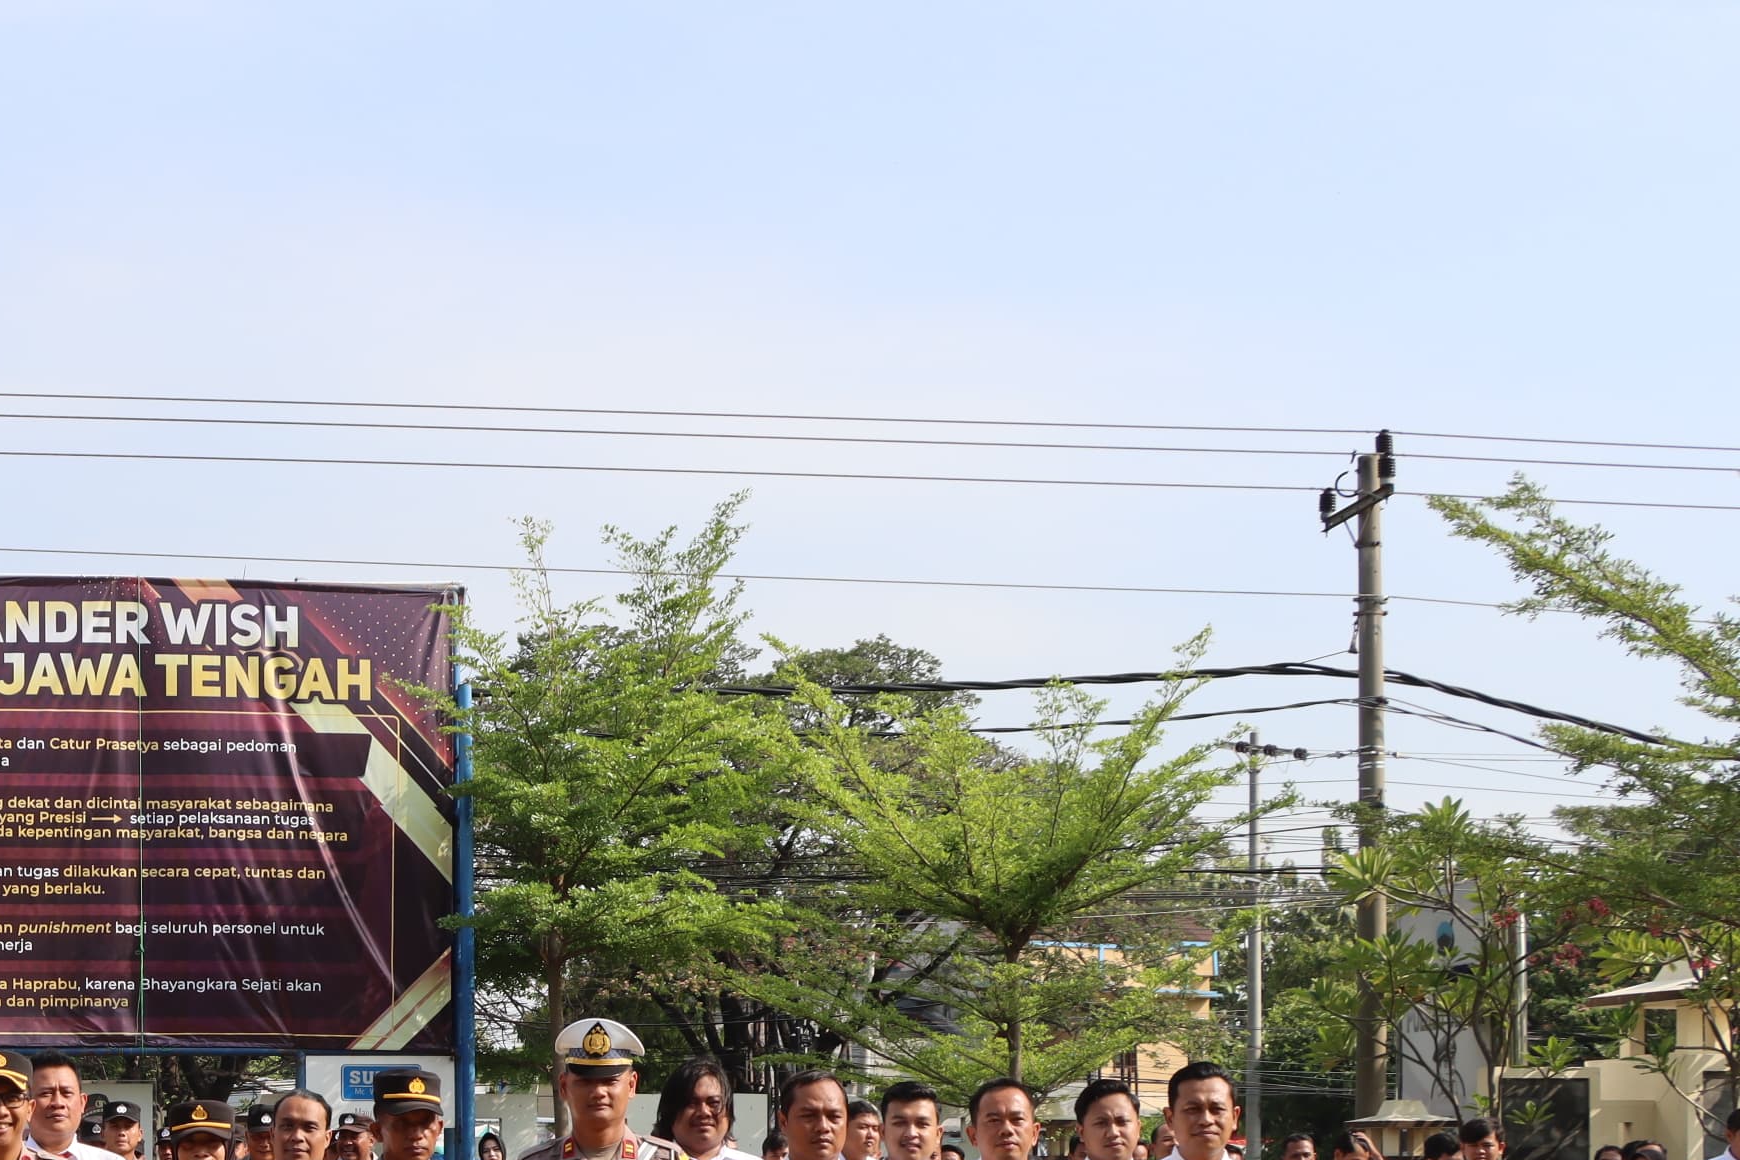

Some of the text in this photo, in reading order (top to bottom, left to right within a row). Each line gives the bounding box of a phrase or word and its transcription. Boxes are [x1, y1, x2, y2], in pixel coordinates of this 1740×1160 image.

[160, 602, 299, 648] WISH
[155, 654, 371, 700] TENGAH
[16, 737, 45, 750] dan
[49, 738, 91, 750] Catur
[96, 738, 159, 754] Prasetya
[163, 739, 221, 754] sebagai
[227, 739, 297, 754] pedoman
[7, 797, 50, 809] dekat
[54, 797, 82, 809] dan
[86, 797, 142, 810] dicintai
[146, 798, 232, 812] masyarakat
[235, 798, 333, 814] sebagaimana
[40, 811, 86, 824] Presisi
[130, 812, 175, 828] setiap
[178, 812, 270, 829] pelaksanaan
[274, 814, 315, 830] tugas
[17, 826, 111, 841] kepentingan
[116, 826, 205, 841] masyarakat,
[208, 827, 262, 842] bangsa
[266, 827, 294, 840] dan
[298, 830, 348, 844] negara
[17, 866, 60, 880] tugas
[63, 865, 138, 879] dilakukan
[141, 867, 190, 878] secara
[194, 866, 242, 881] cepat,
[244, 867, 293, 880] tuntas
[297, 867, 326, 880] dan
[2, 884, 40, 898] yang
[44, 881, 105, 895] berlaku.
[17, 921, 112, 938] punishment
[115, 922, 147, 937] bagi
[151, 922, 208, 935] seluruh
[212, 922, 276, 938] personel
[280, 923, 325, 936] untuk
[12, 978, 81, 995] Haprabu,
[85, 978, 135, 991] karena
[141, 978, 237, 994] Bhayangkara
[242, 979, 282, 994] Sejati
[286, 979, 322, 992] akan
[6, 996, 35, 1008] dan
[40, 995, 129, 1010] pimpinanya
